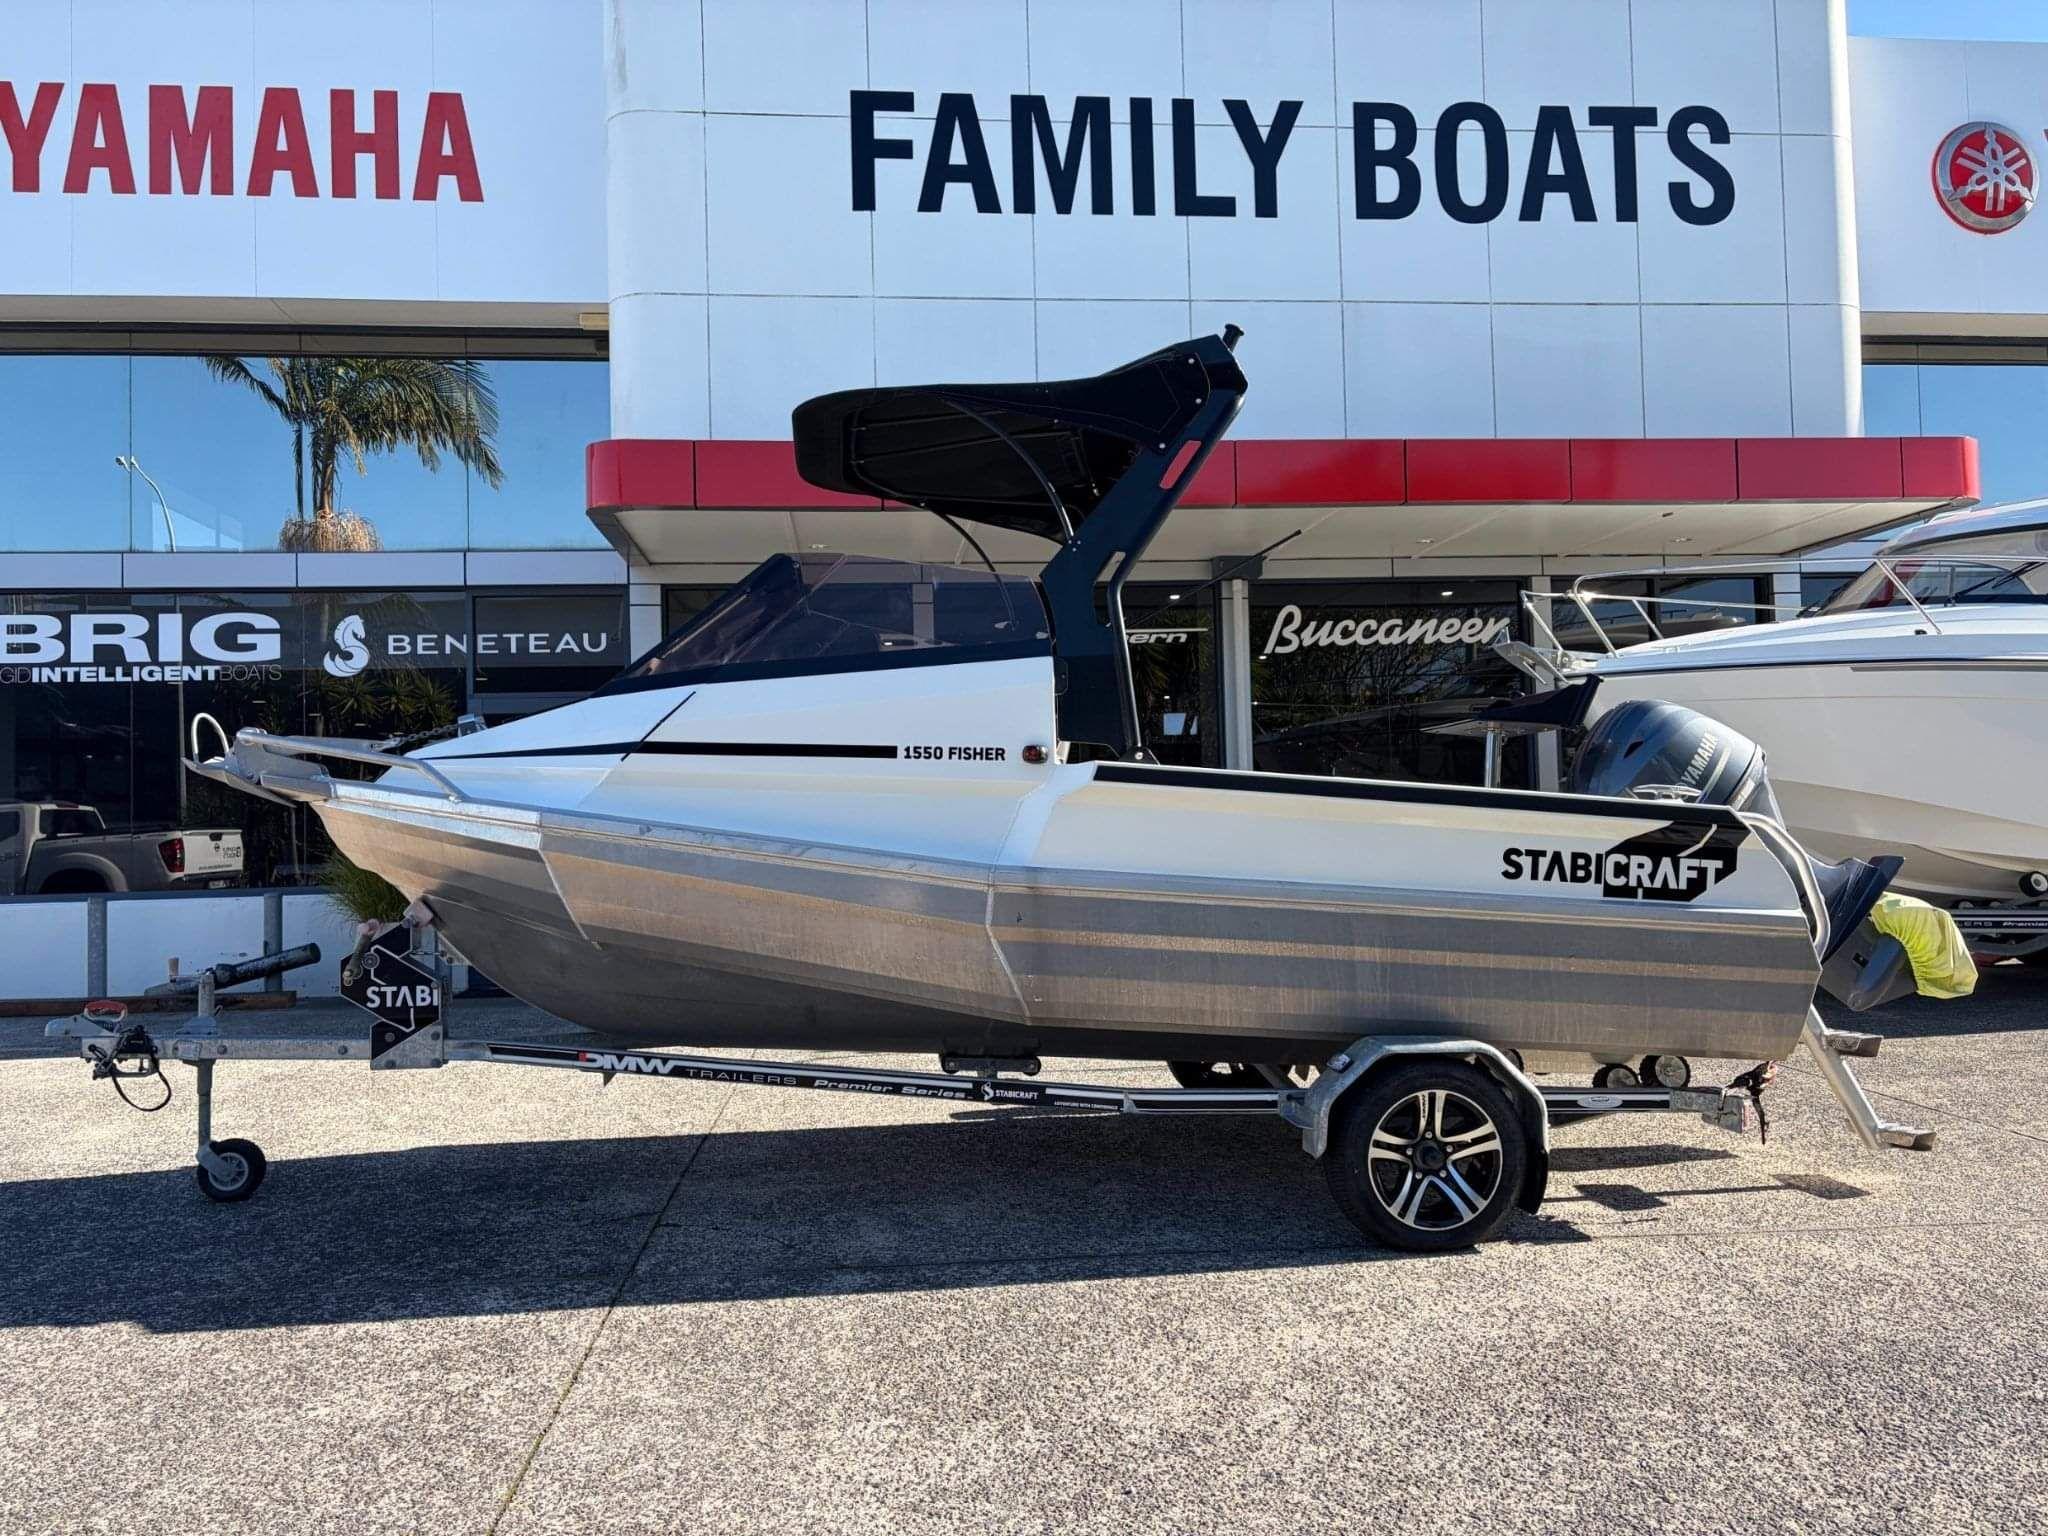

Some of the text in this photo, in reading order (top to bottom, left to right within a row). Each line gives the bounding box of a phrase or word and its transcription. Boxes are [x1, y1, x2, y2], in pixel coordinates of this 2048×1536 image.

[0, 81, 484, 203] YAMAHA
[850, 89, 1735, 226] FAMILY BOATS
[0, 612, 281, 664] BRIG
[387, 632, 608, 655] BENETEAU
[1264, 604, 1511, 655] Buccaneer
[903, 746, 1006, 761] 1550 FISHER
[1680, 730, 1719, 785] YAMAHA
[1501, 846, 1724, 891] STABICRAFT
[366, 985, 439, 1008] STABI
[577, 1049, 966, 1099] DMW TRAILERS Premier Series
[995, 1089, 1039, 1100] STABICRAFT
